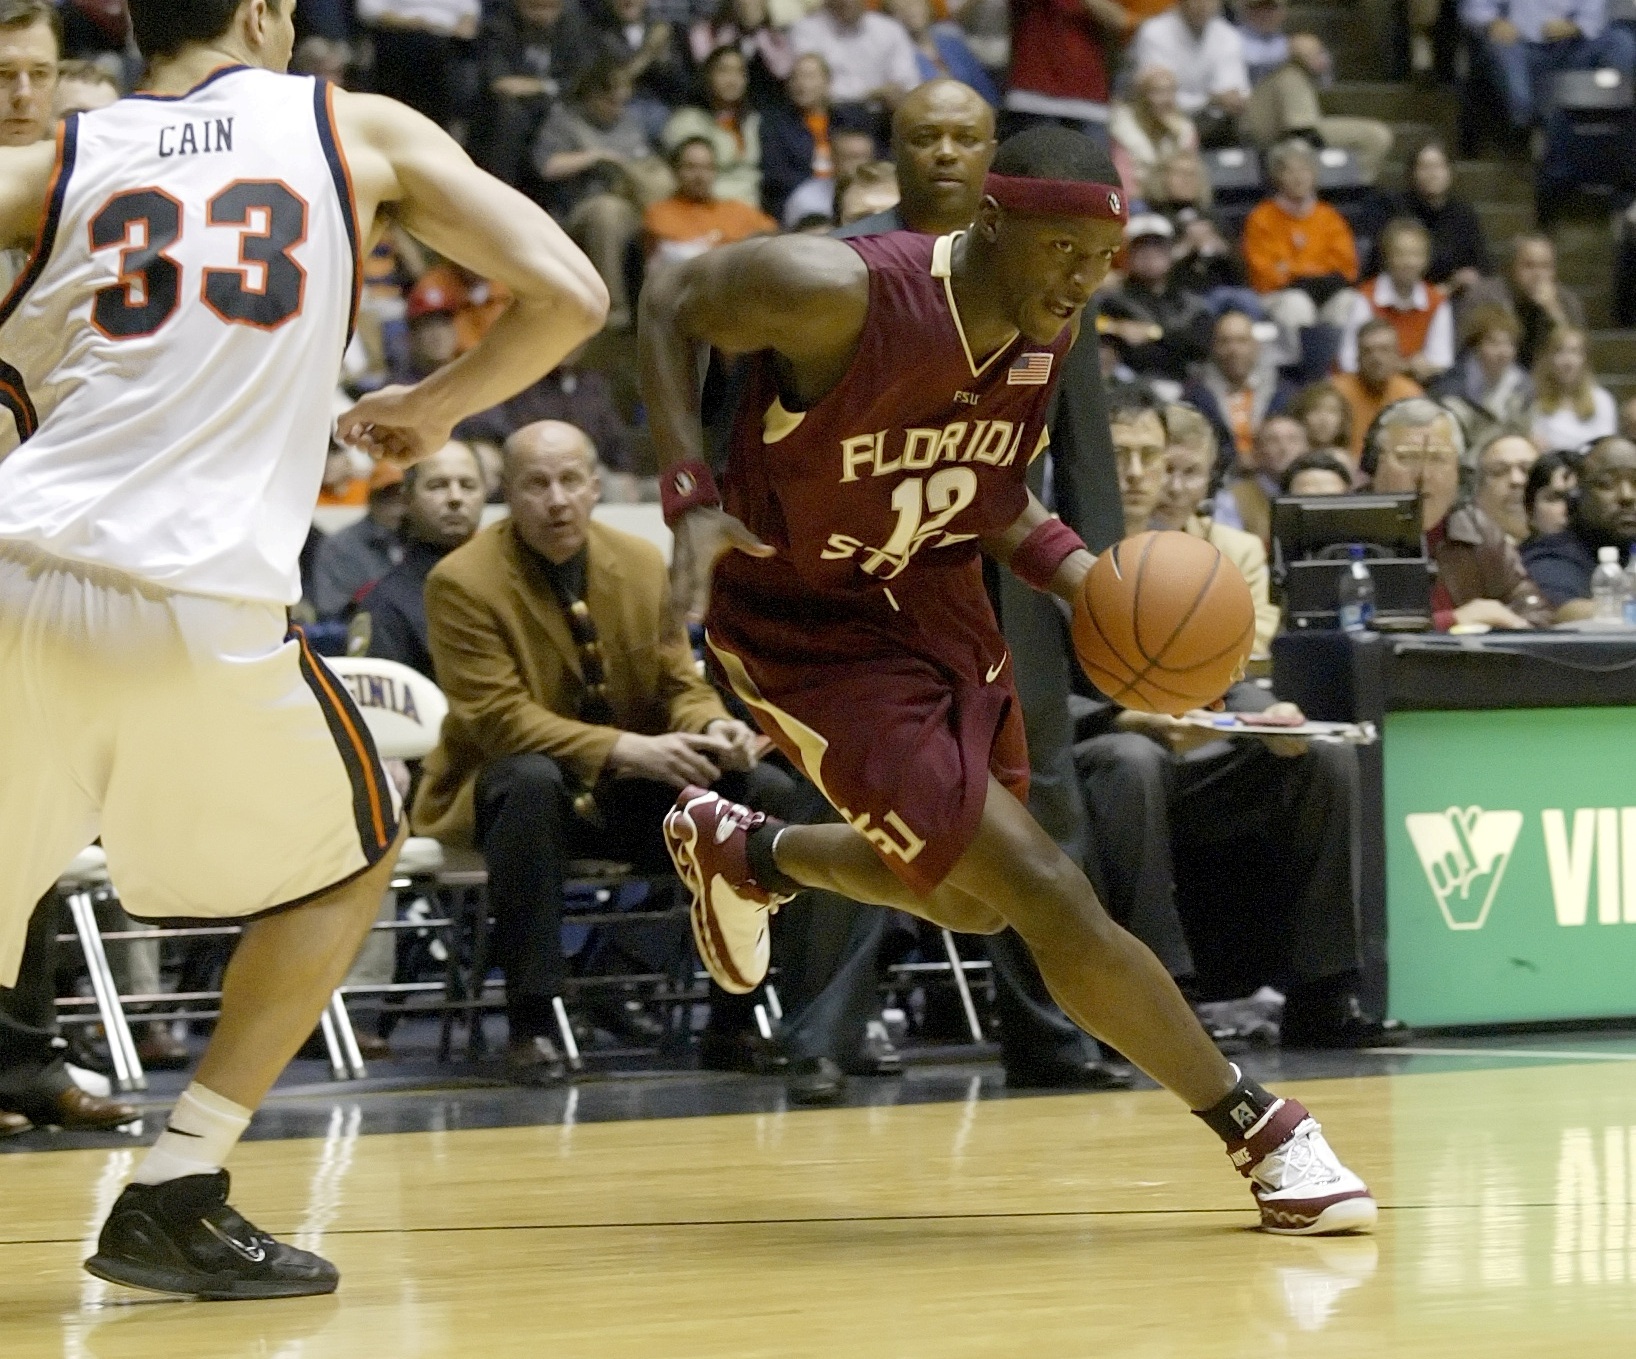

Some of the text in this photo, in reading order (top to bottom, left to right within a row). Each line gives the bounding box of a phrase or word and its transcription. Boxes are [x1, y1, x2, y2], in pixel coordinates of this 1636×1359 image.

[158, 117, 234, 157] CAIN
[88, 178, 309, 341] 33
[953, 390, 981, 406] FSU
[839, 419, 1025, 483] FLORIDA
[891, 466, 978, 557] 12
